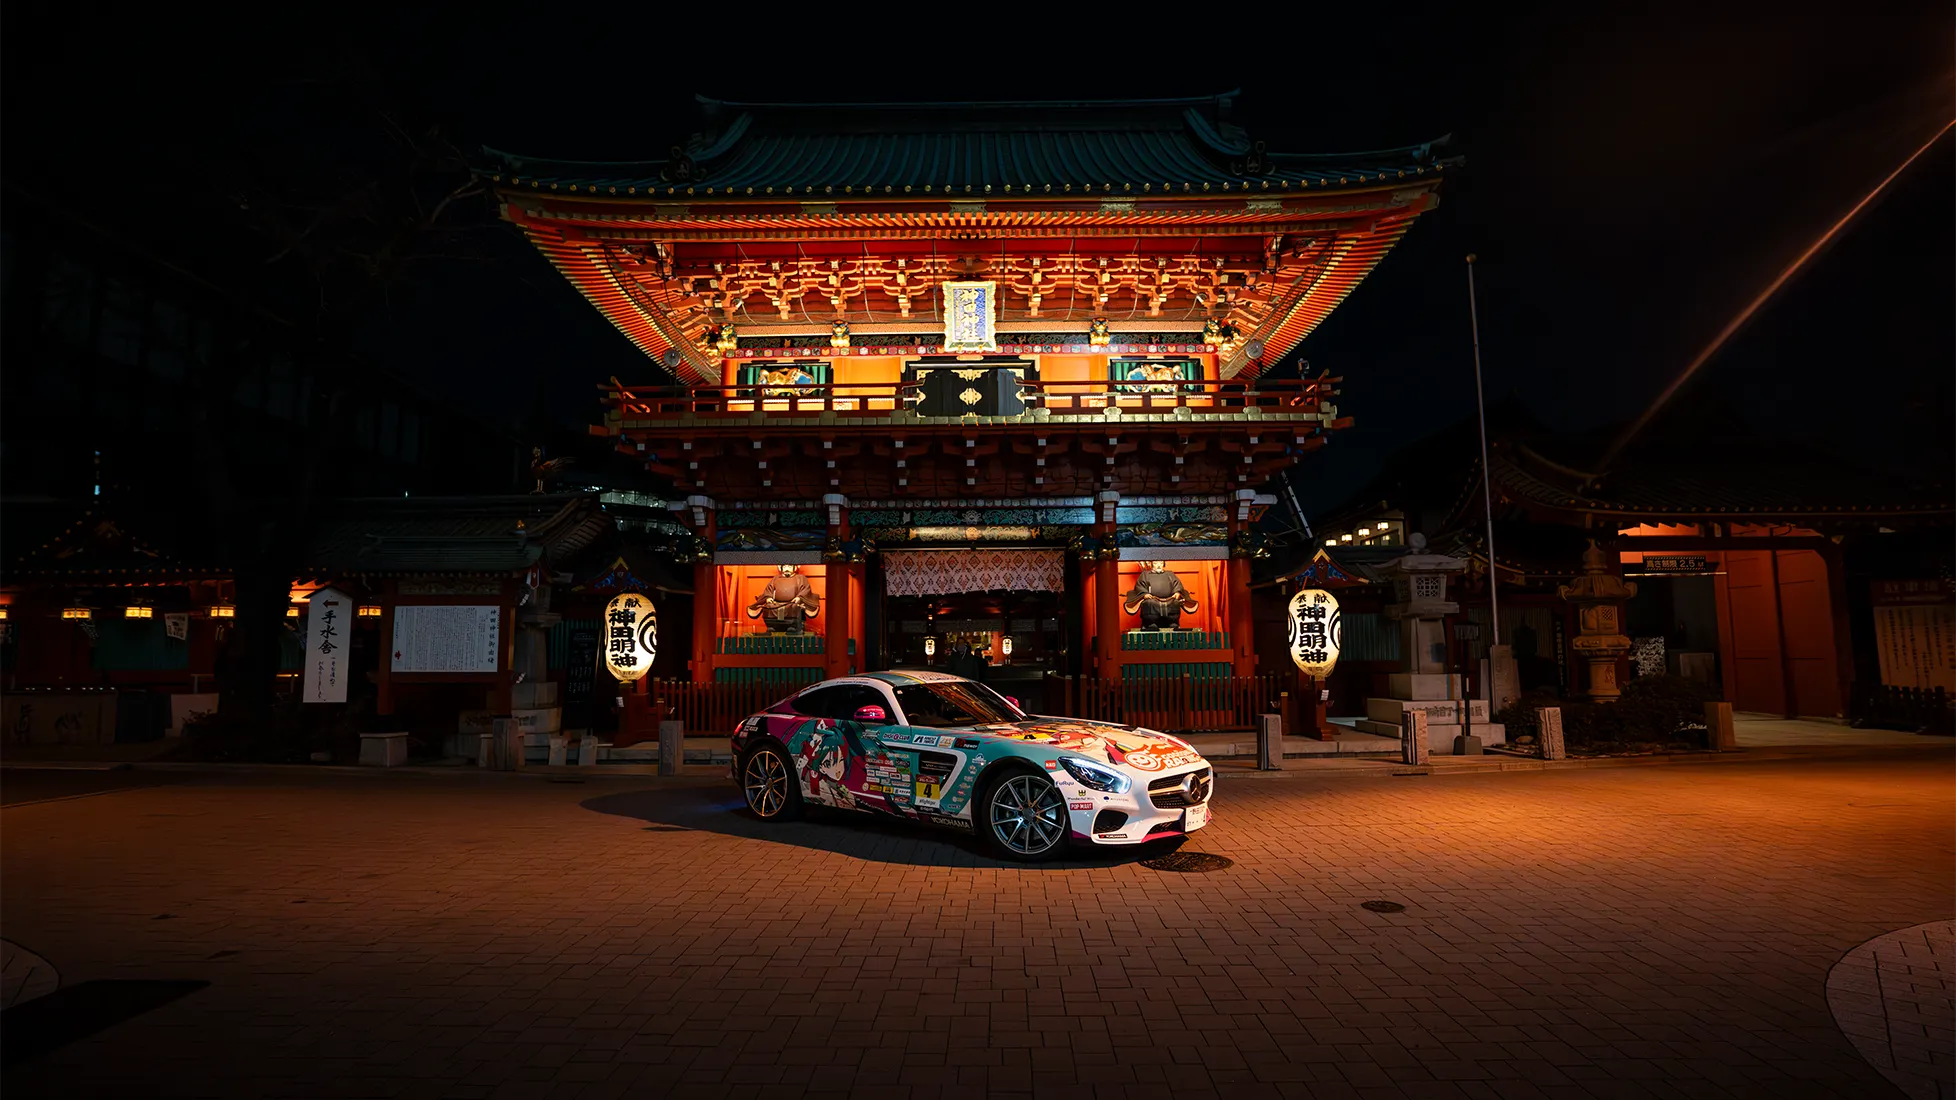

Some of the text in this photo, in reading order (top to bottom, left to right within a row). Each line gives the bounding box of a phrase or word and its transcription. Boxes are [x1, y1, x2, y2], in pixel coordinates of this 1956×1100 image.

[1679, 560, 1696, 568] 2.5
[608, 608, 638, 668] 神田明神
[1296, 603, 1328, 664] 神田明神
[923, 784, 932, 798] 4
[930, 816, 971, 829] YOKOHAMA
